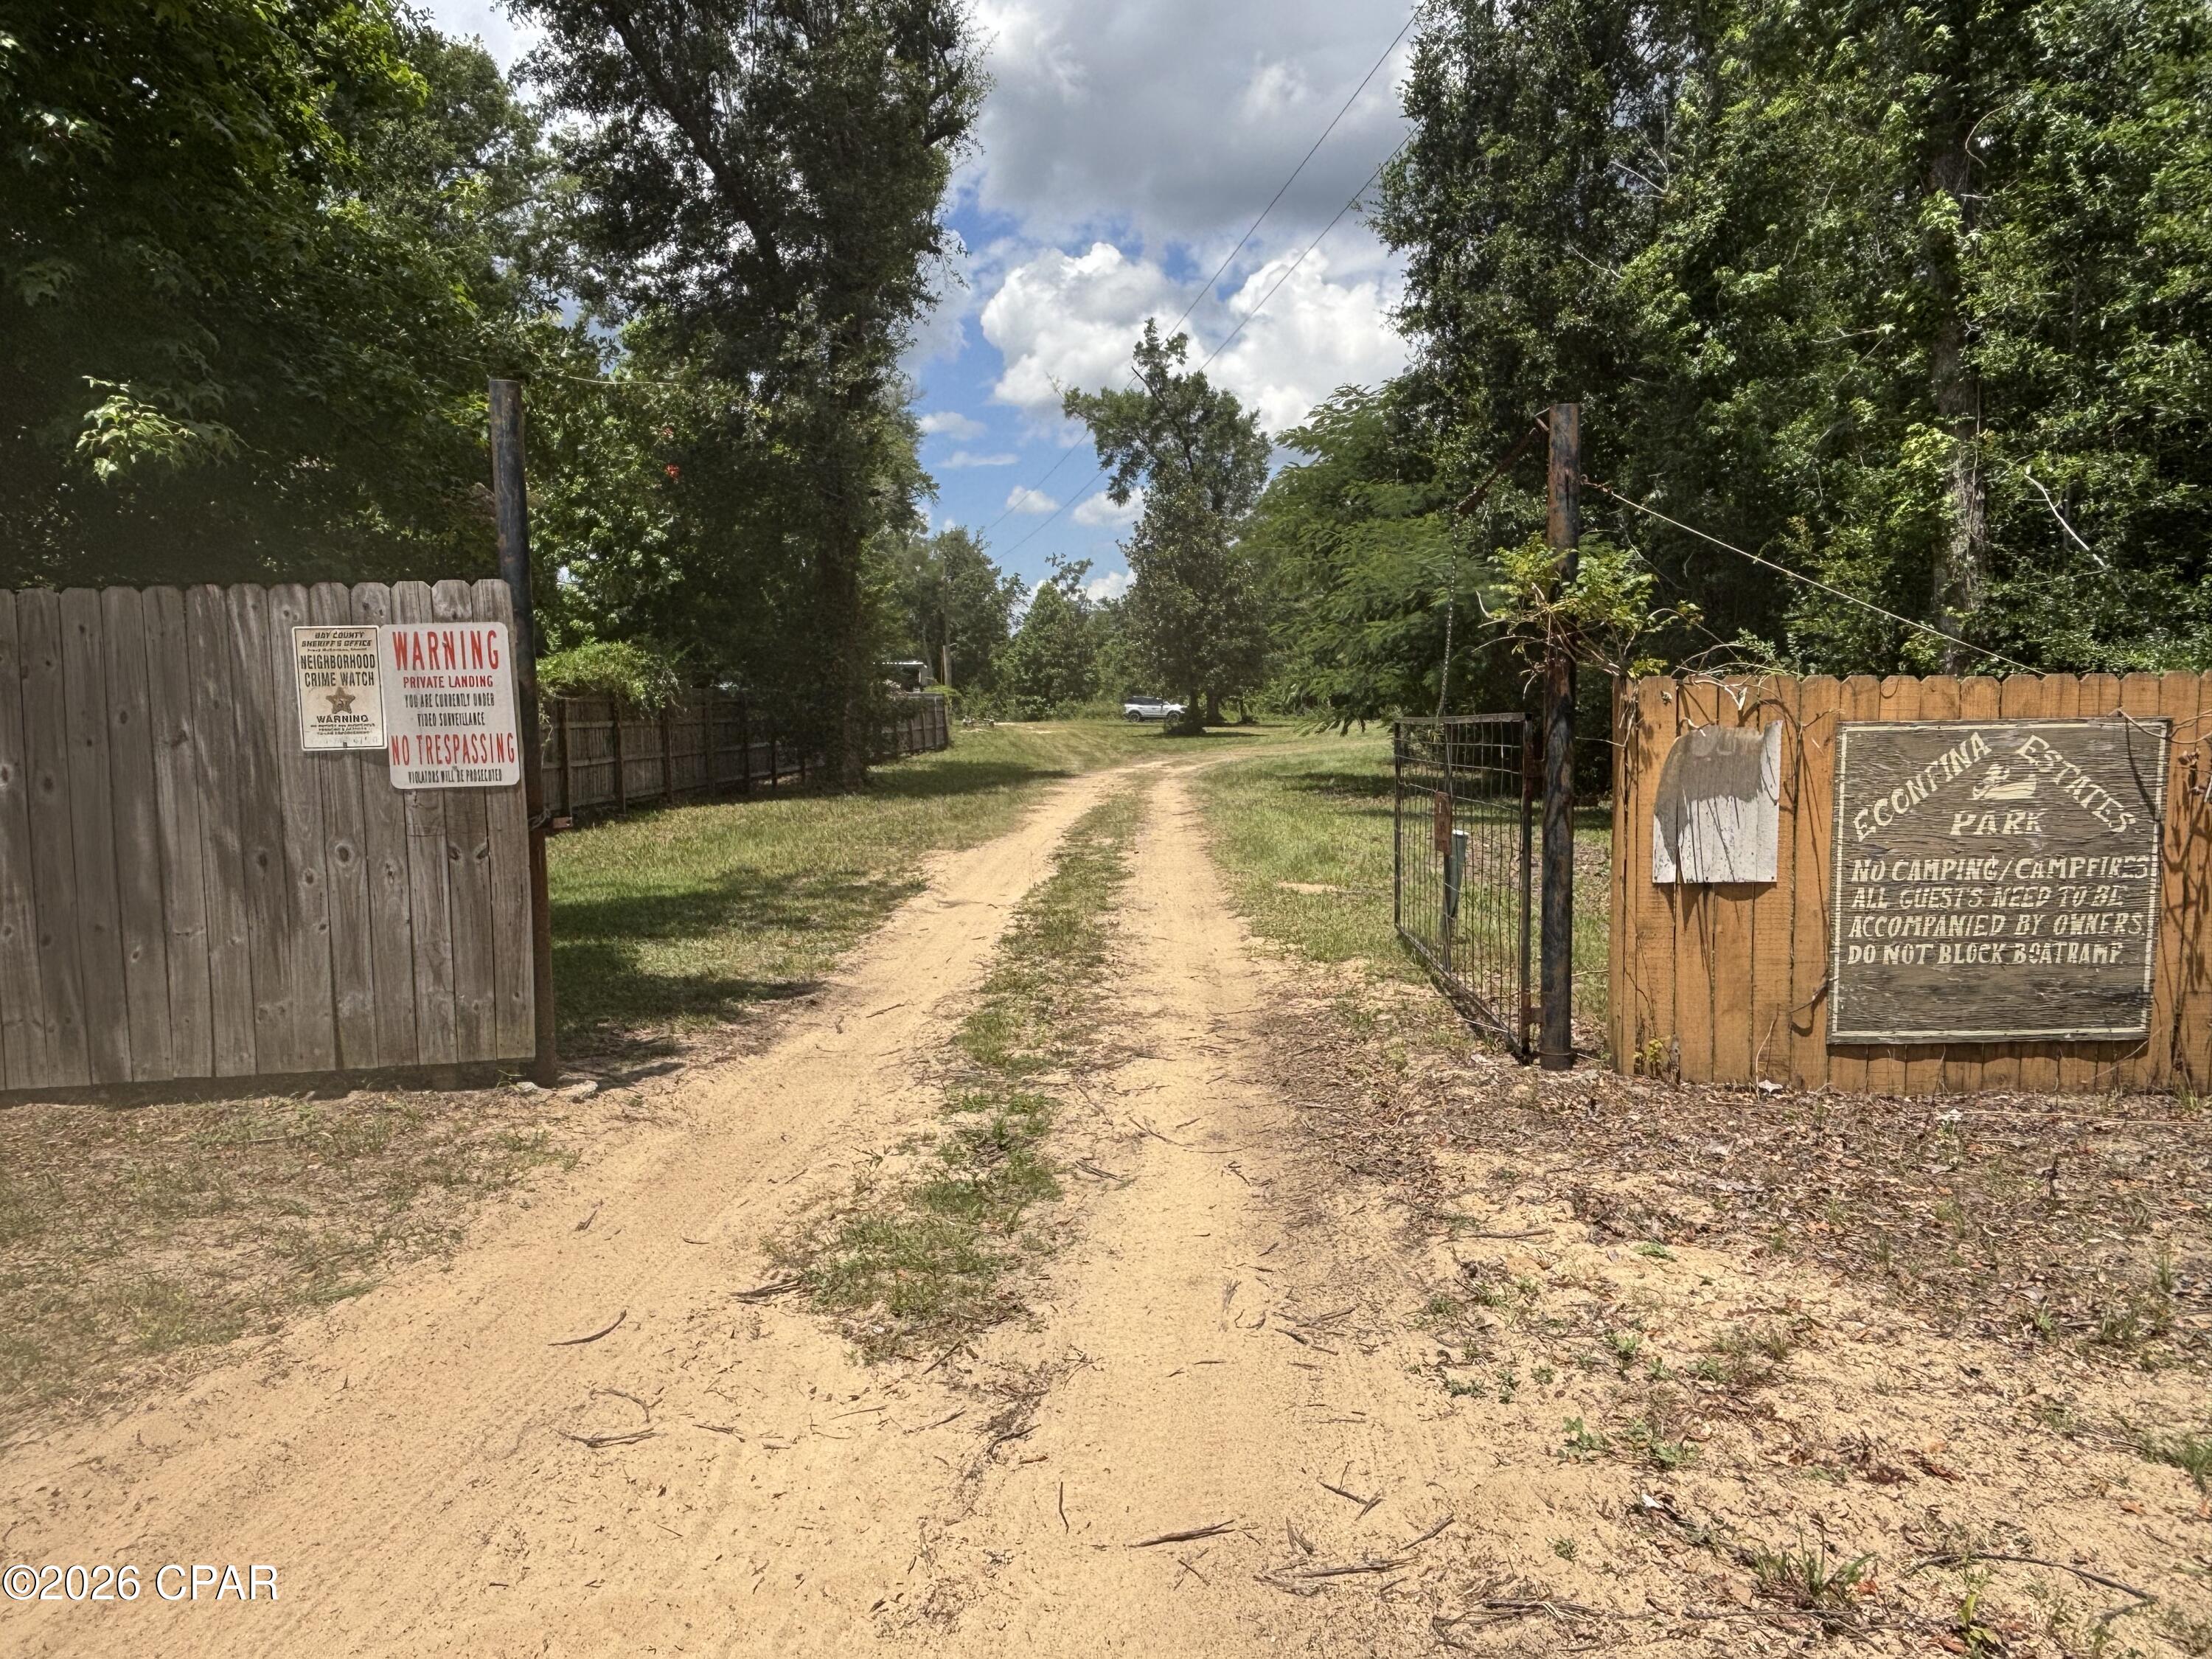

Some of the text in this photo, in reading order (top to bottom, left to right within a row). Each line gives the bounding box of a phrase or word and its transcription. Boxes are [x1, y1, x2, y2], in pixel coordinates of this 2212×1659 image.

[300, 653, 375, 669] NEIGHBORHOOD
[392, 630, 499, 671] WARNING
[305, 671, 375, 687] CRIME WATCH
[403, 675, 493, 688] PRIVATE LANDING
[405, 692, 495, 708] YOU ARE CURRENTLY UNDER
[316, 714, 369, 723] WARNING
[417, 712, 485, 727] VIDEO SURVEILLANCE
[391, 732, 515, 766] NO TRESPASSING
[408, 768, 502, 784] VIOLATORS WILL BE PROSECUTED
[1852, 732, 2136, 842] ECONFINA ESTATES
[1950, 809, 2048, 835] PARK
[1851, 858, 1886, 882] NO
[1851, 887, 1888, 909] ALL
[1991, 886, 2052, 908] NEED
[2058, 886, 2088, 908] TO
[2090, 885, 2126, 907] BE
[1848, 914, 2006, 938] ACCOMPANIED
[2014, 914, 2046, 936] BY
[1847, 944, 1877, 965] DO
[1882, 943, 1934, 965] NOT
[1936, 943, 2007, 964] BLOCK
